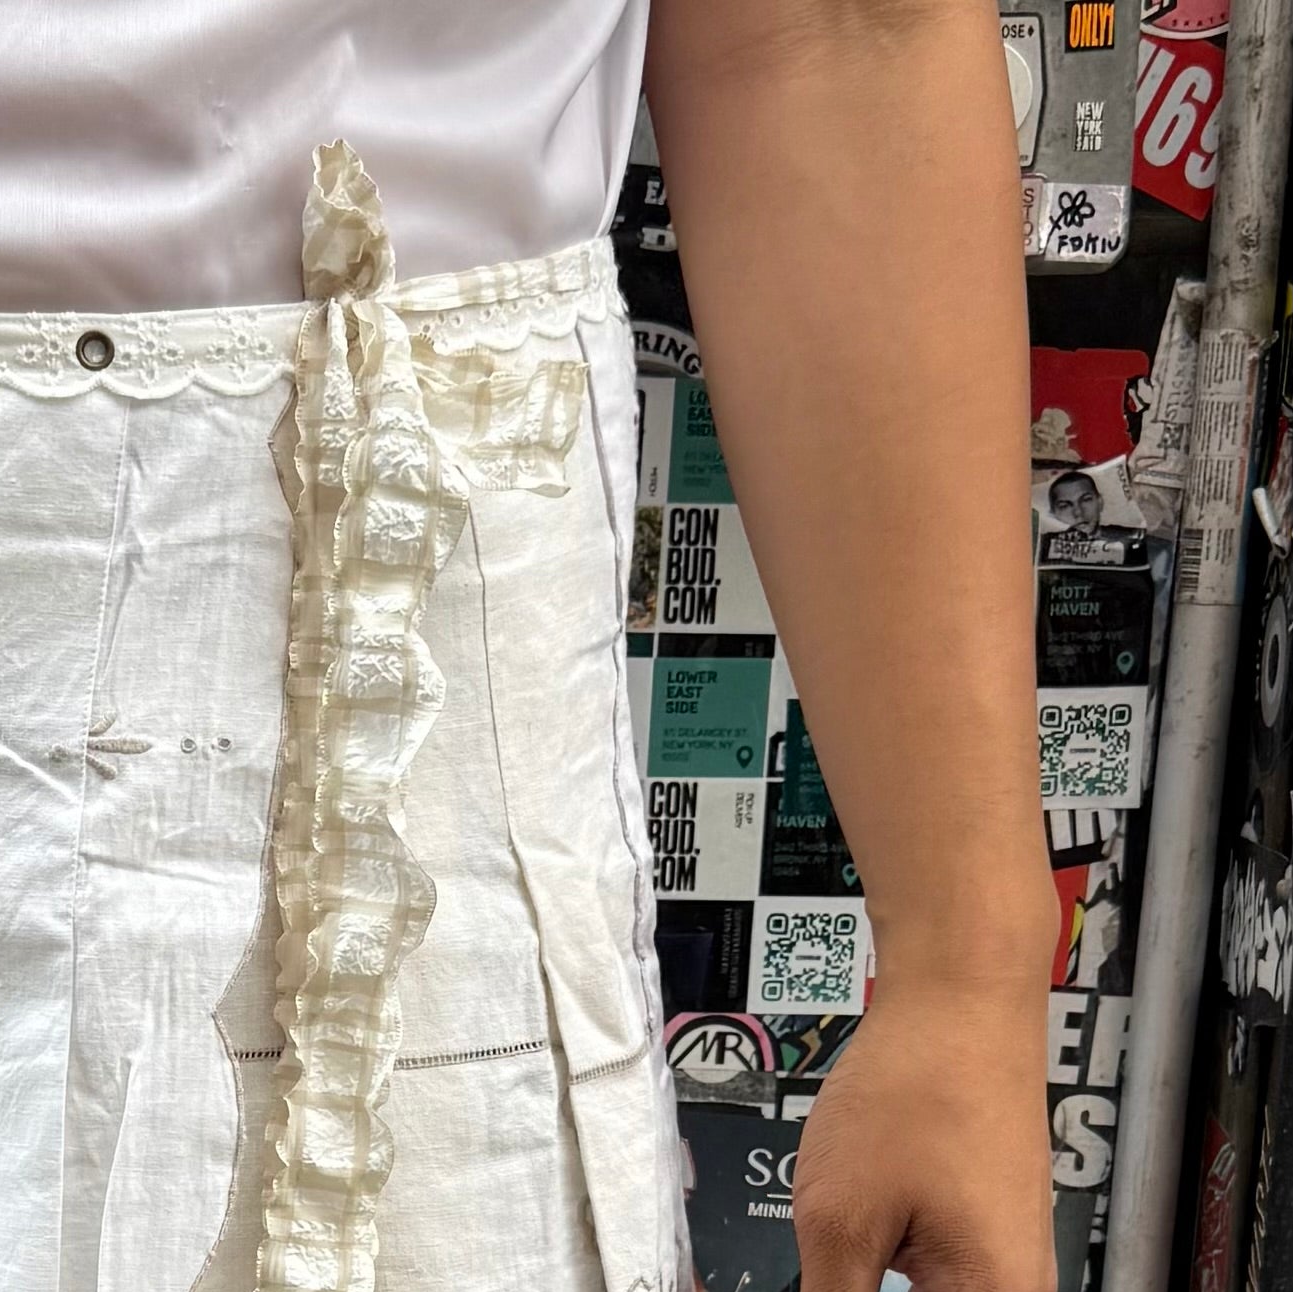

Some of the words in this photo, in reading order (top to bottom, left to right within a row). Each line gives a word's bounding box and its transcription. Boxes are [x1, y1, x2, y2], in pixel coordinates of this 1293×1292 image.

[1001, 24, 1025, 38] OSE
[1076, 102, 1104, 120] NEW
[1076, 120, 1103, 136] YORK
[634, 331, 703, 375] RING
[669, 508, 719, 547] CON
[666, 547, 721, 586] BUD.
[1051, 586, 1092, 600] MOTT
[663, 586, 718, 624] COM
[1050, 602, 1100, 616] HAVEN
[667, 671, 718, 684] LOWER
[667, 686, 704, 699] EAST
[665, 701, 699, 714] SIDE
[649, 782, 698, 818] CON
[776, 815, 827, 828] HAVEN
[648, 819, 700, 855] BUD.
